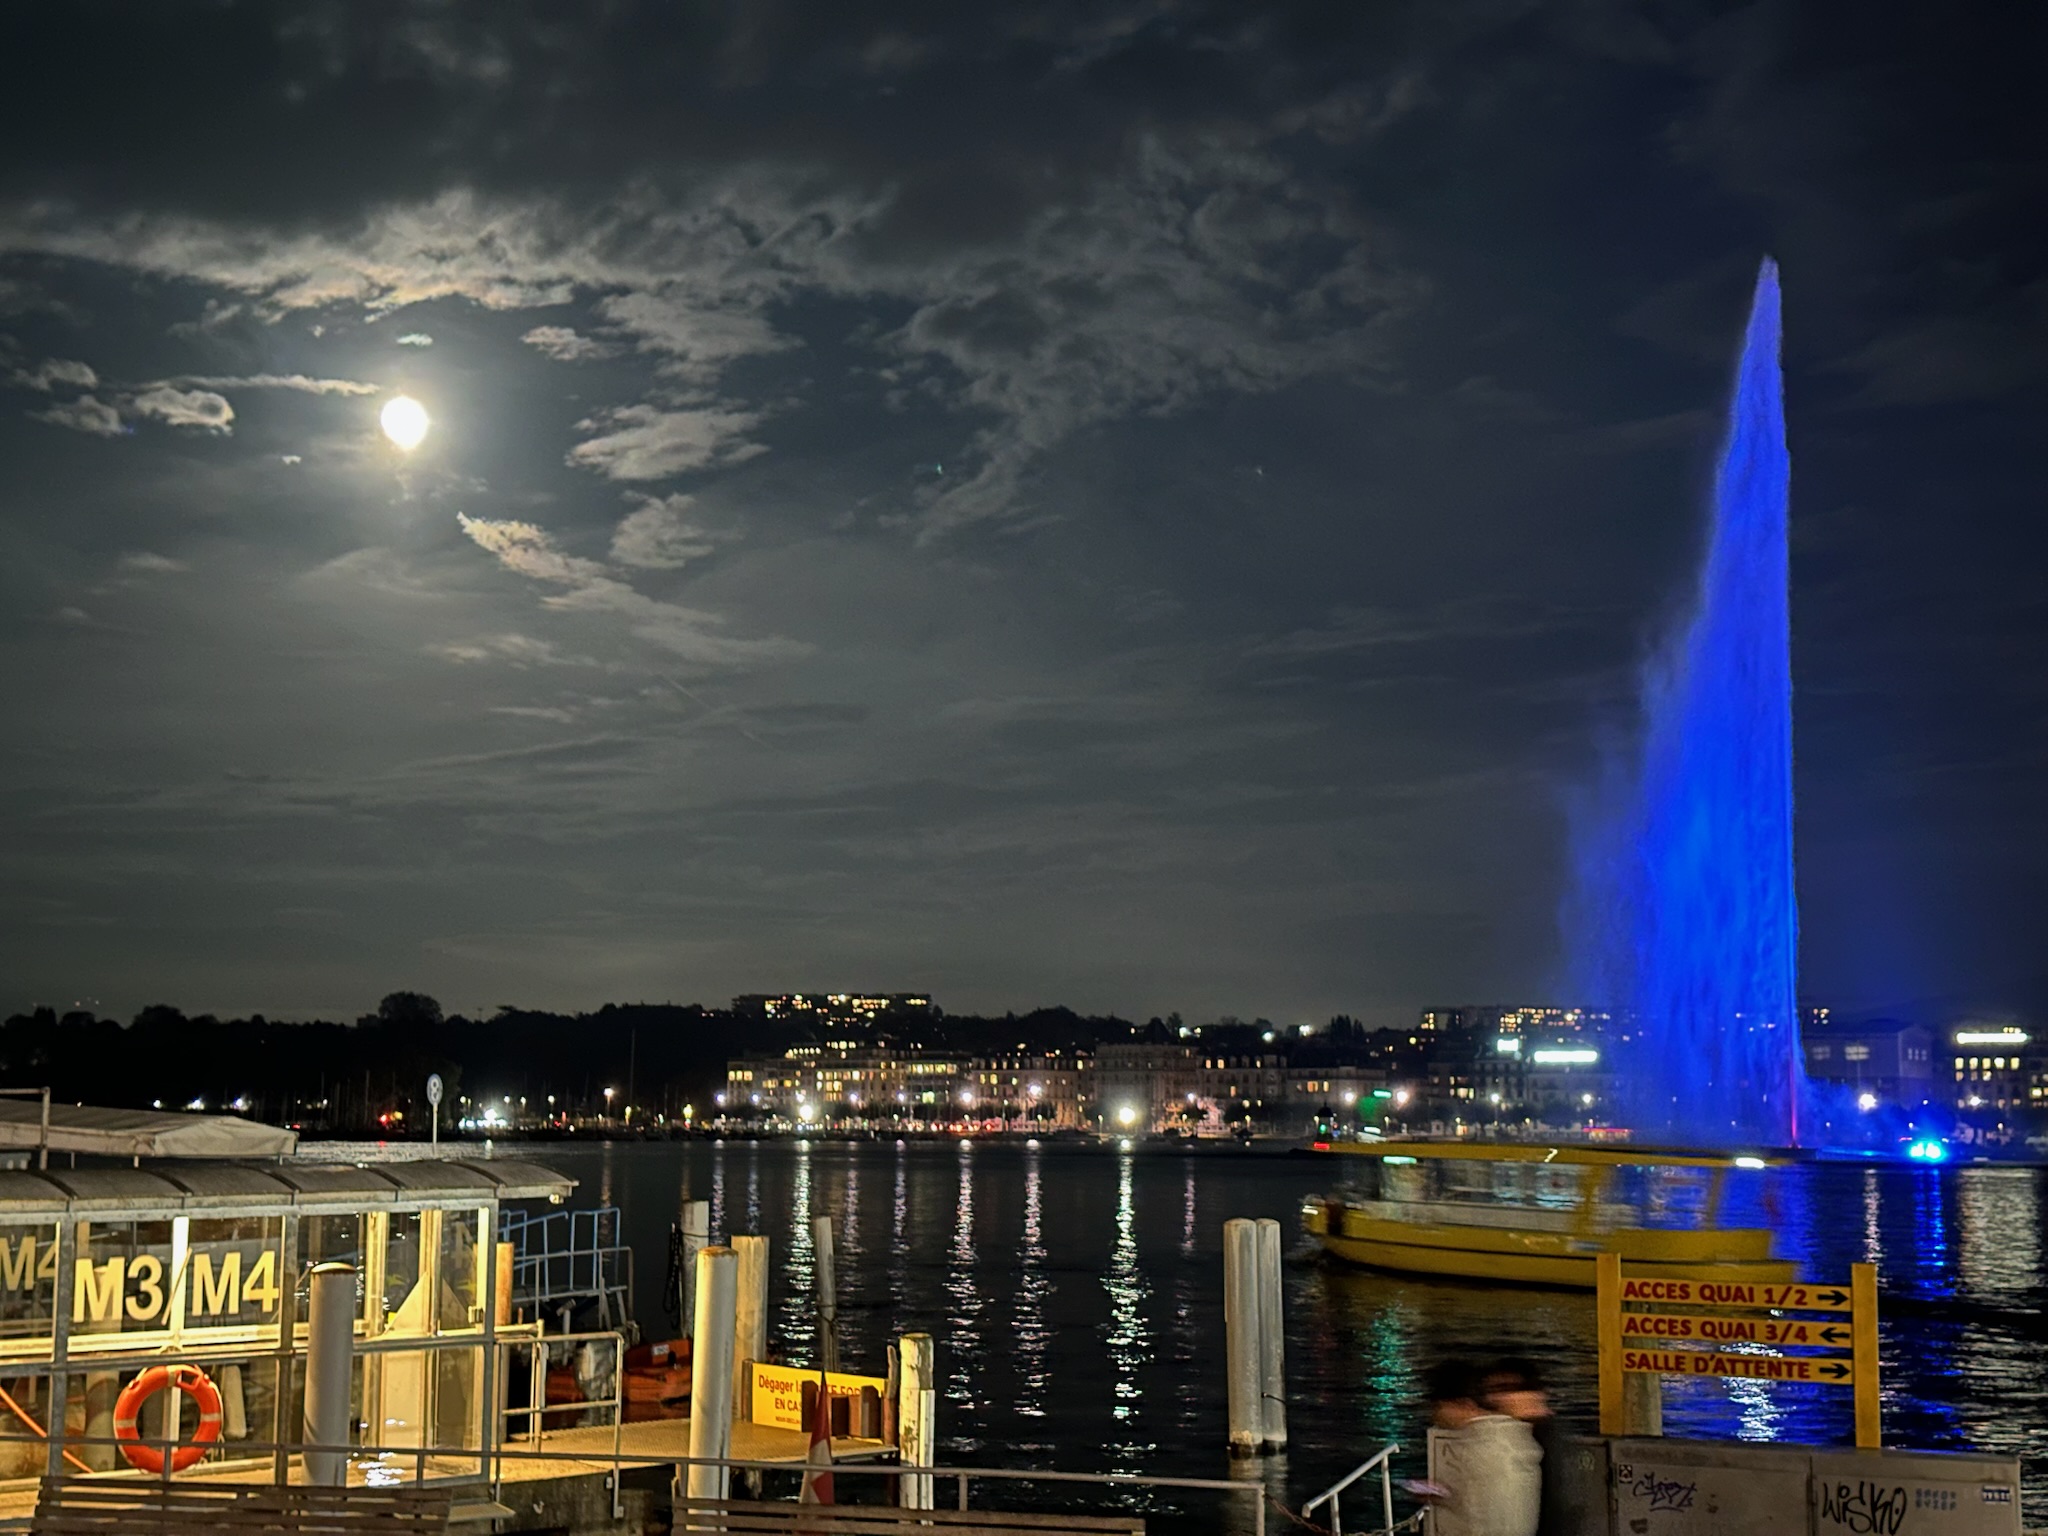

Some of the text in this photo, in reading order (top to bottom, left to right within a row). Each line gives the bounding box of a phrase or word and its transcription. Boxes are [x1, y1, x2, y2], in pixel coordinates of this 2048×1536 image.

[1624, 1281, 1808, 1306] ACCES QUAI 1/2
[1624, 1317, 1808, 1342] ACCES QUAI 3/4
[1625, 1352, 1810, 1379] SALLE D'ATTENTE
[758, 1374, 794, 1395] Dégager
[774, 1398, 785, 1410] EN
